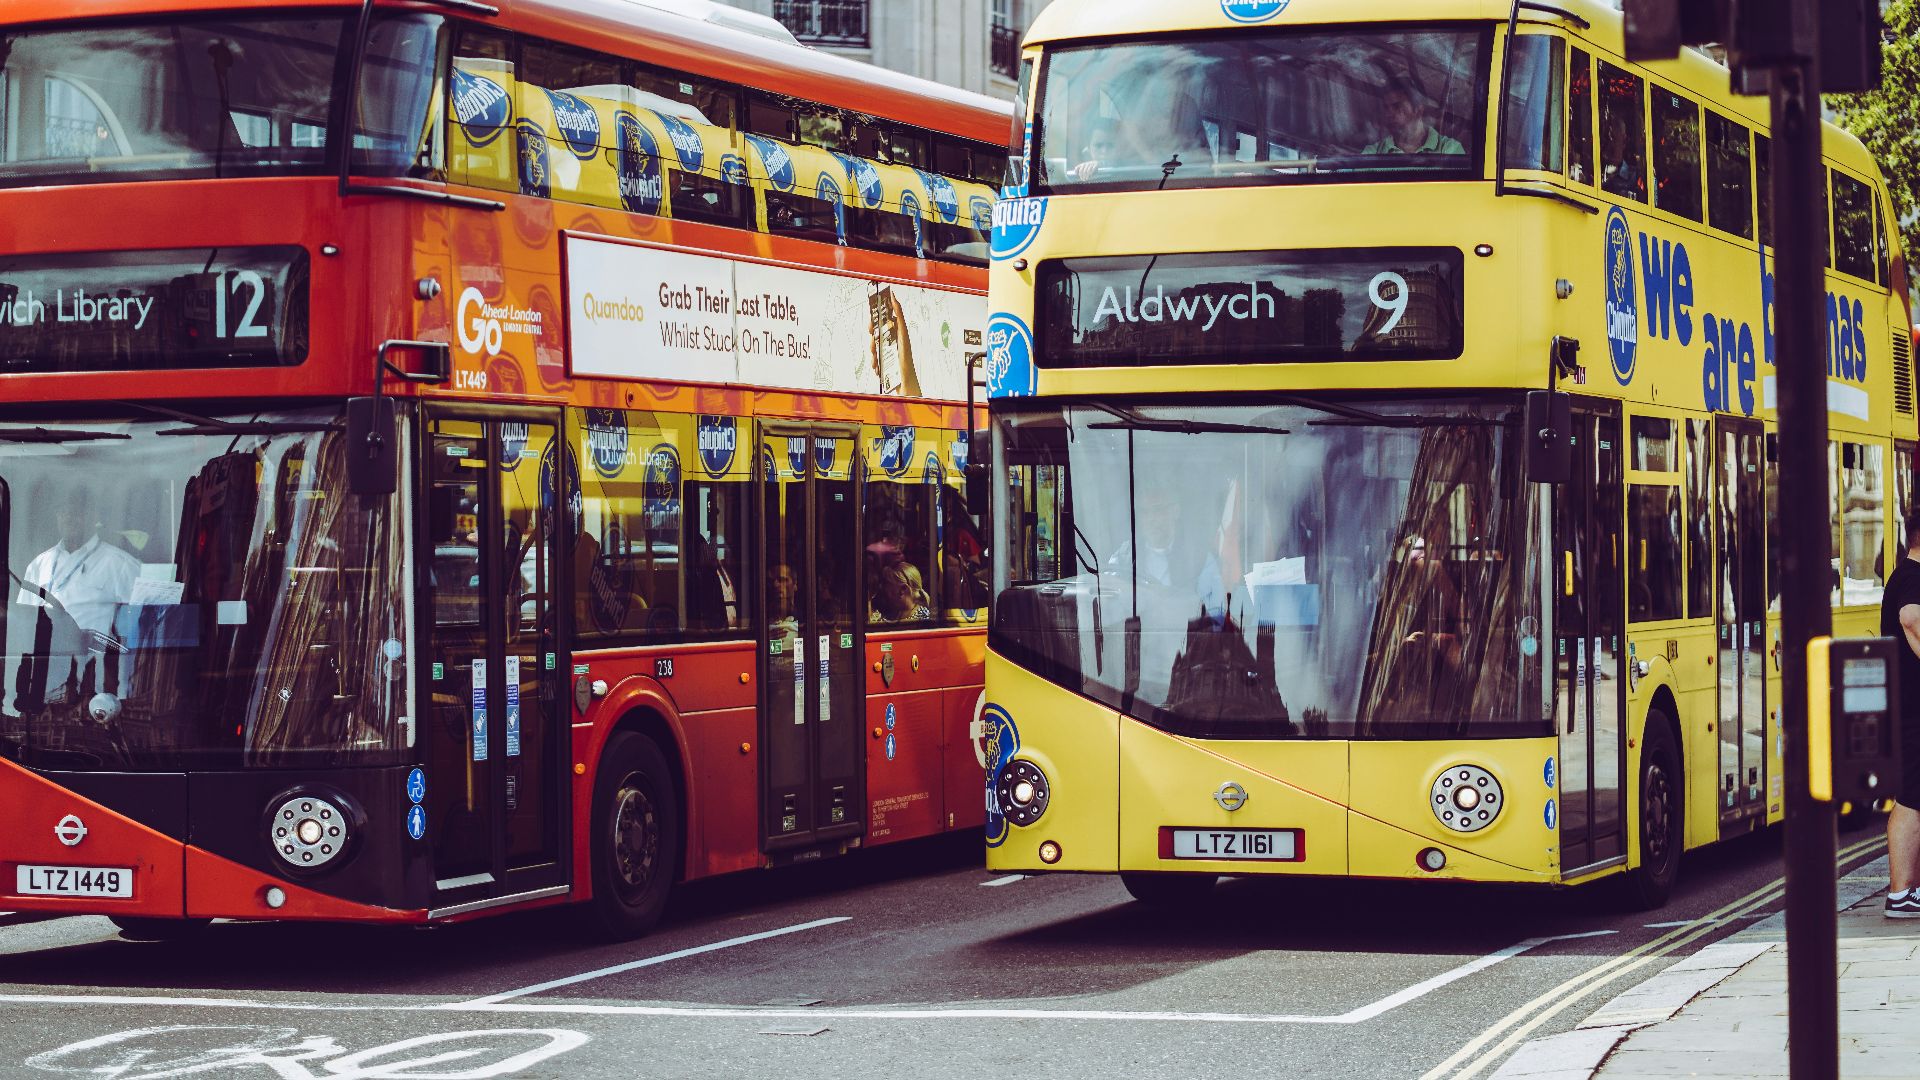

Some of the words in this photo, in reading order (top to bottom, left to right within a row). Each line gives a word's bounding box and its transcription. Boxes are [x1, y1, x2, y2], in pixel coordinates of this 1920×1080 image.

[57, 289, 153, 330] Library
[215, 270, 268, 338] 12
[458, 287, 502, 356] Go
[583, 292, 644, 325] Quandoo
[659, 282, 692, 310] Grab
[696, 286, 730, 314] Their
[735, 294, 761, 318] Last
[763, 294, 799, 326] Table,
[1093, 281, 1275, 332] Aldwych
[1368, 271, 1408, 335] 9
[660, 320, 700, 350] Whilst
[704, 326, 739, 353] Stuck
[742, 329, 760, 354] On
[763, 331, 785, 357] The
[788, 333, 811, 359] Bus!
[1639, 231, 1694, 347] we
[1702, 312, 1756, 416] are
[456, 369, 487, 390] LT449
[601, 447, 637, 466] Dulwich
[639, 446, 669, 469] Library
[657, 659, 673, 676] 238
[1195, 833, 1236, 854] LTZ
[1242, 834, 1273, 854] 1161
[29, 868, 69, 891] LTZ
[74, 870, 120, 893] 1449
